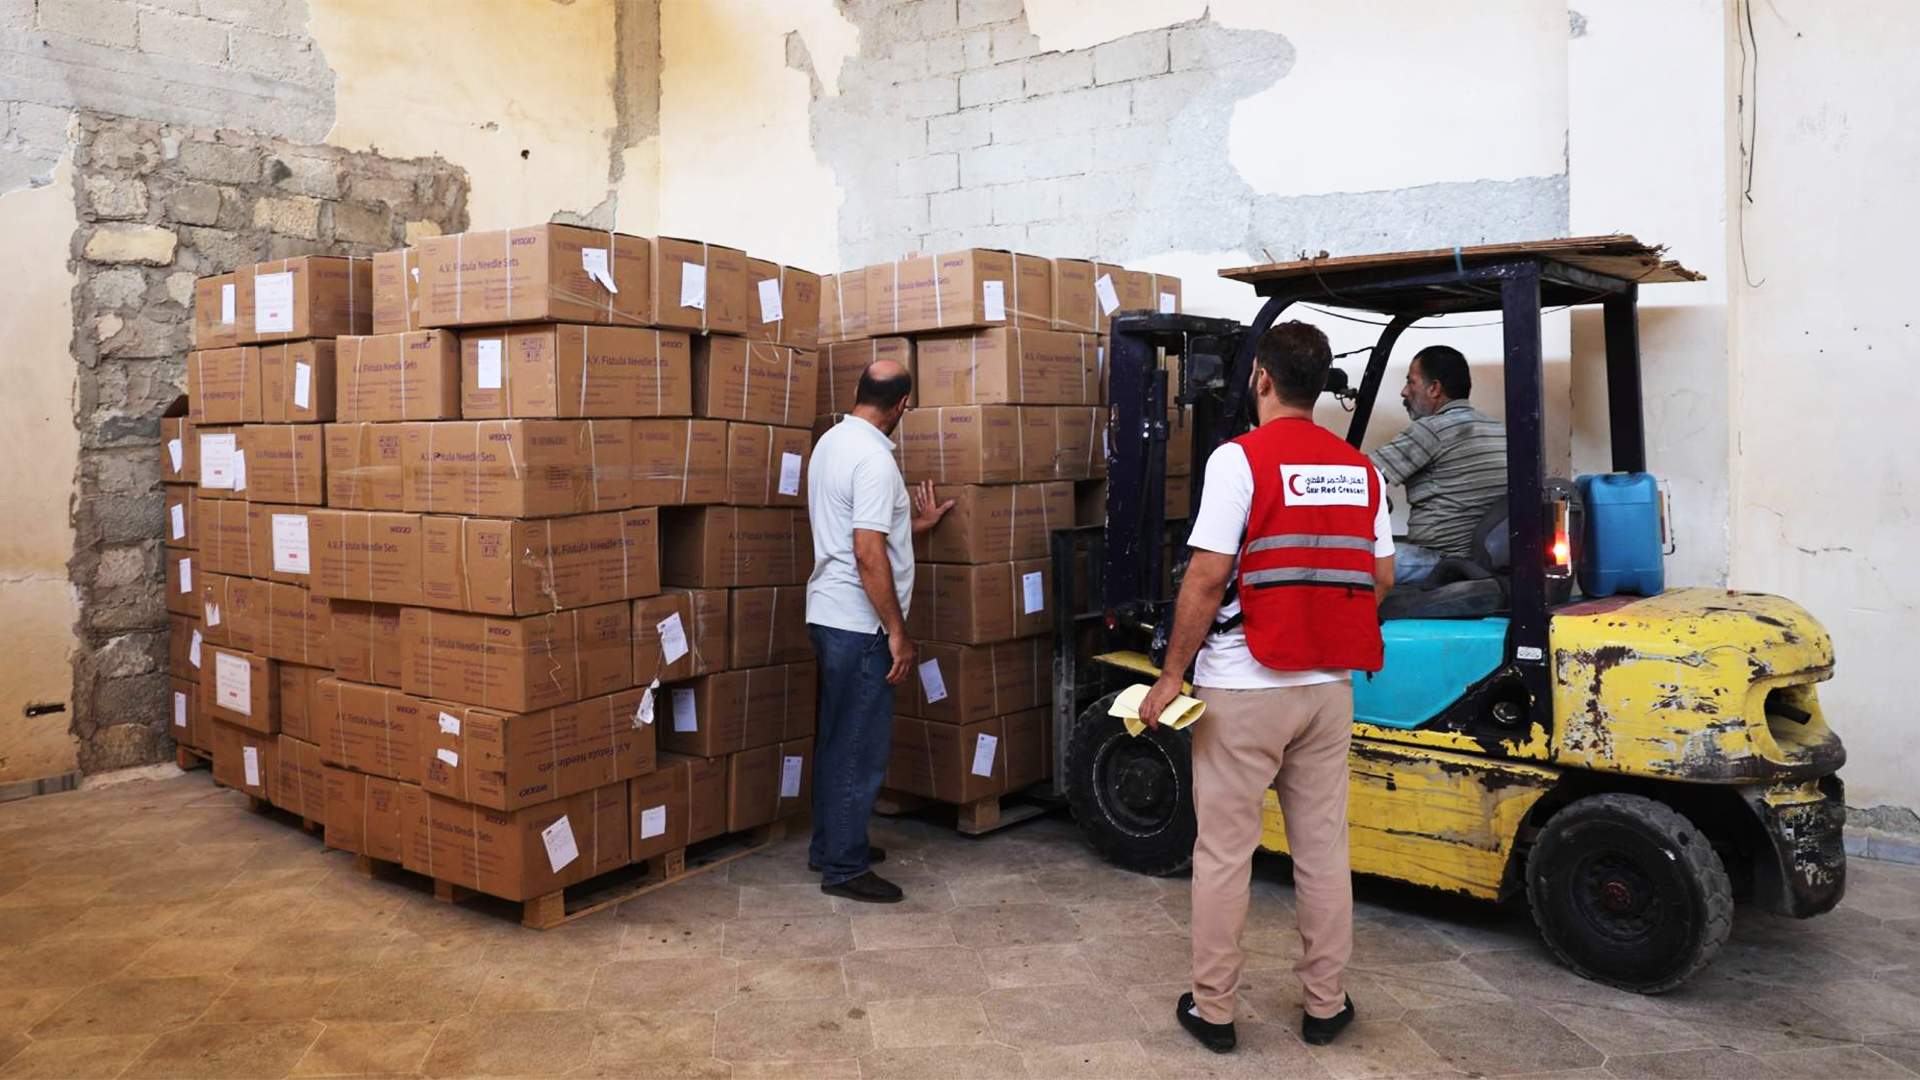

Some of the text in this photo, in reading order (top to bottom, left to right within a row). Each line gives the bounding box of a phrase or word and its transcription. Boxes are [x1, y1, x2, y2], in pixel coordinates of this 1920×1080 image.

[456, 452, 476, 462] Needl
[481, 452, 496, 462] Sets
[454, 825, 475, 837] Needl
